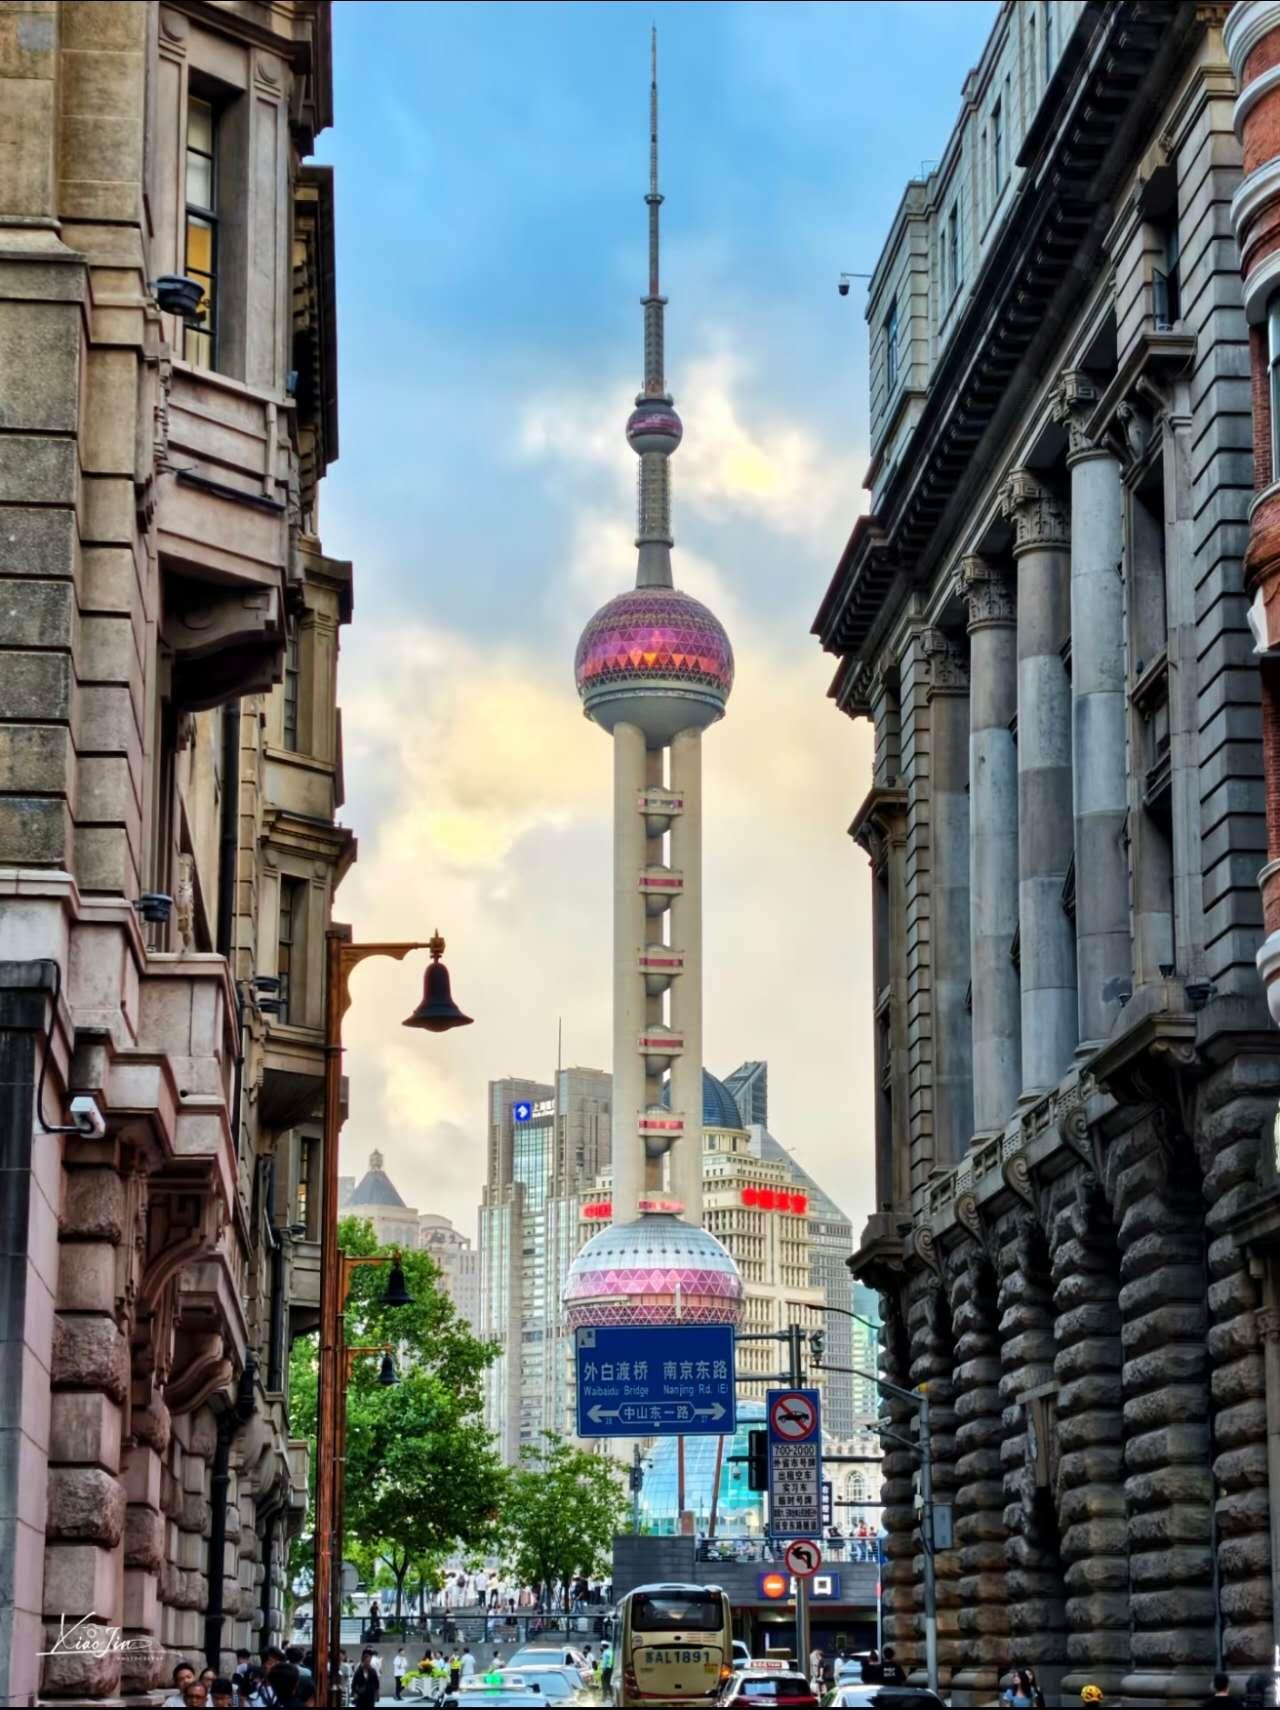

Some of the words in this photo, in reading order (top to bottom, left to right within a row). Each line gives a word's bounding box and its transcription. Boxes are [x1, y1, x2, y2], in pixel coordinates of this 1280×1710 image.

[583, 1361, 648, 1382] 外白渡桥
[663, 1360, 728, 1381] 南京东路
[583, 1385, 620, 1396] Waibaidu
[624, 1385, 649, 1397] Bridge
[663, 1384, 695, 1397] Nanjing
[623, 1405, 690, 1420] 中山东一路
